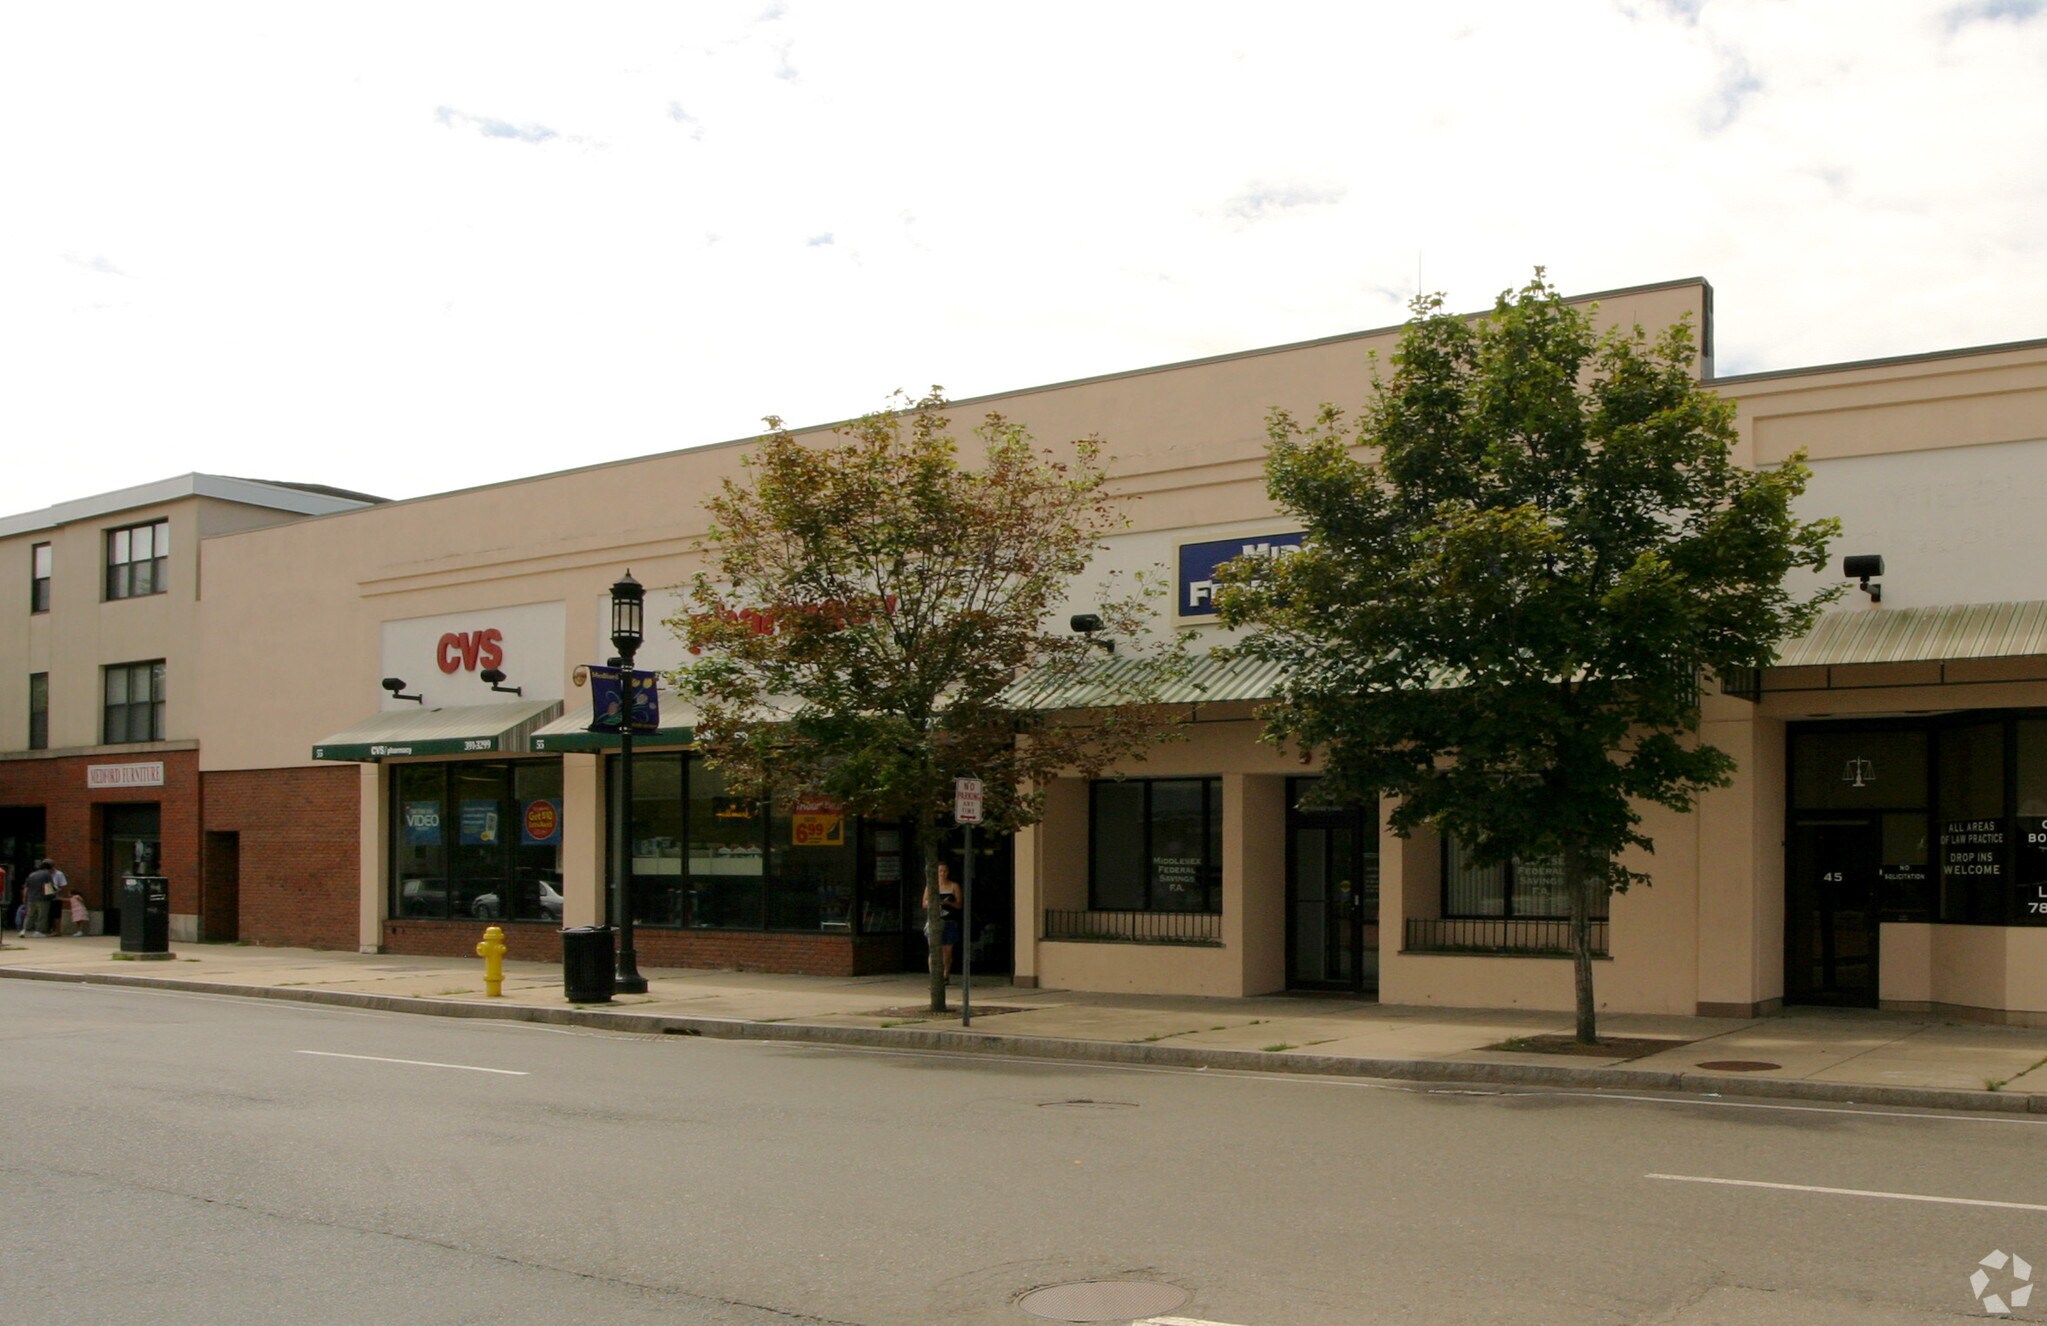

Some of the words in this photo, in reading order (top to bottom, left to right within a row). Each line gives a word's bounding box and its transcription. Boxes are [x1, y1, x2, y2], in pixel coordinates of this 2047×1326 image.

[437, 628, 503, 674] CVS
[90, 768, 120, 784] MEDFORD
[122, 766, 160, 783] FURNITURE
[964, 783, 975, 791] NO
[957, 792, 982, 801] PARKING
[405, 814, 440, 827] VIDEO
[1948, 823, 1964, 833] ALL
[1966, 821, 1995, 832] AREAS
[1940, 835, 1950, 845] OF
[1951, 834, 1967, 844] LAW
[1968, 833, 2004, 844] PRACTICE
[1950, 852, 1974, 863] DROP
[1977, 852, 1993, 862] INS
[1943, 865, 2001, 875] WELCOME
[1823, 872, 1843, 882] 45
